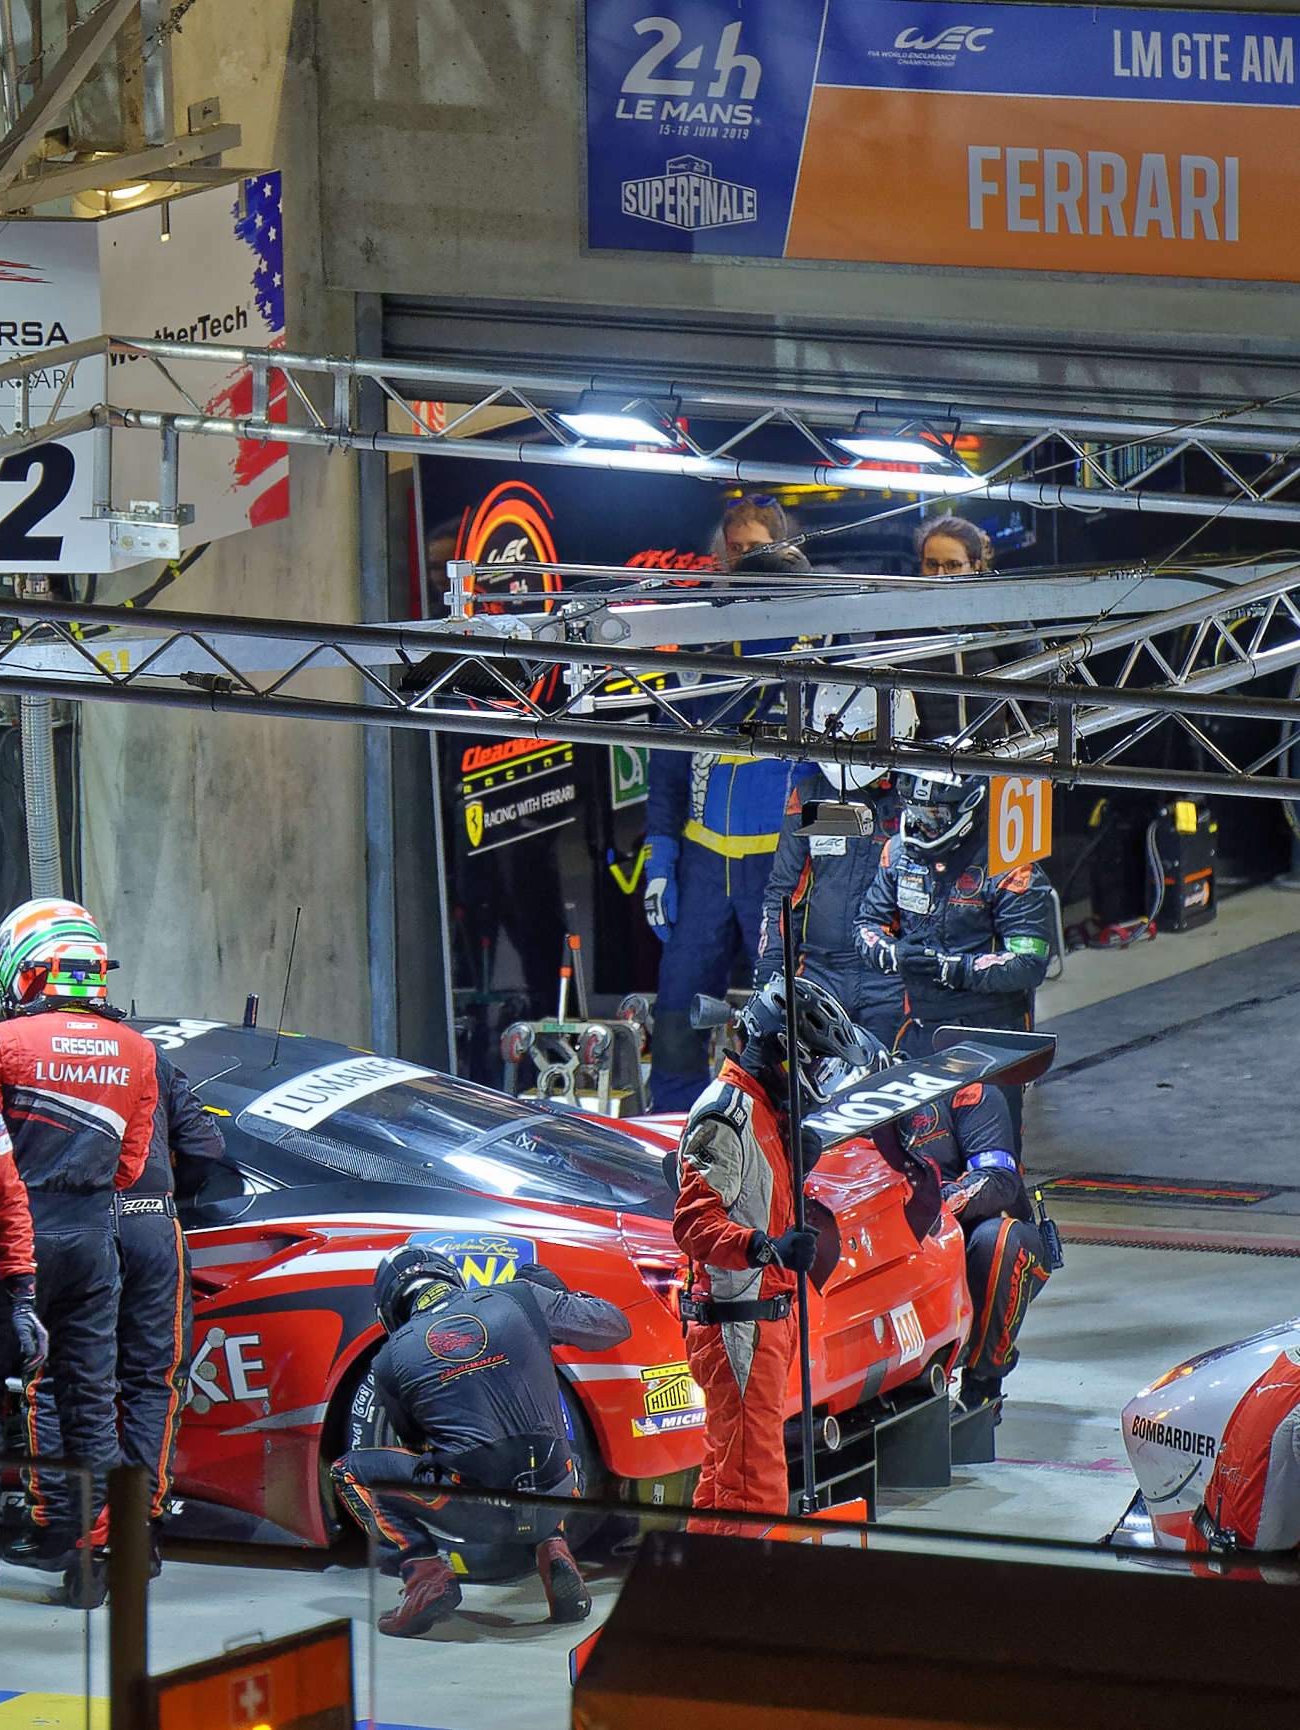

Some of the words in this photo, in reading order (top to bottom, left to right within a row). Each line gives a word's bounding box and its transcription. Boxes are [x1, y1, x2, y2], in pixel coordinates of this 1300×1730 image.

[620, 16, 762, 99] 24h
[1113, 29, 1162, 78] LM
[1172, 32, 1231, 81] GTE
[1241, 35, 1294, 84] AM
[615, 98, 656, 120] LE
[660, 101, 753, 125] MANS
[659, 124, 689, 137] 15-16
[692, 126, 718, 138] JUIN
[722, 127, 750, 140] 2019
[625, 176, 754, 227] SUPERFINALE
[967, 145, 1239, 241] FERRARI
[110, 306, 247, 366] therTech
[517, 796, 540, 817] WITH
[999, 777, 1042, 863] 61
[52, 1037, 119, 1056] CRESSONI
[36, 1062, 130, 1086] LUMAIKE
[278, 1060, 406, 1113] LUMAIKE
[1132, 1415, 1216, 1459] BOMBARDIER
